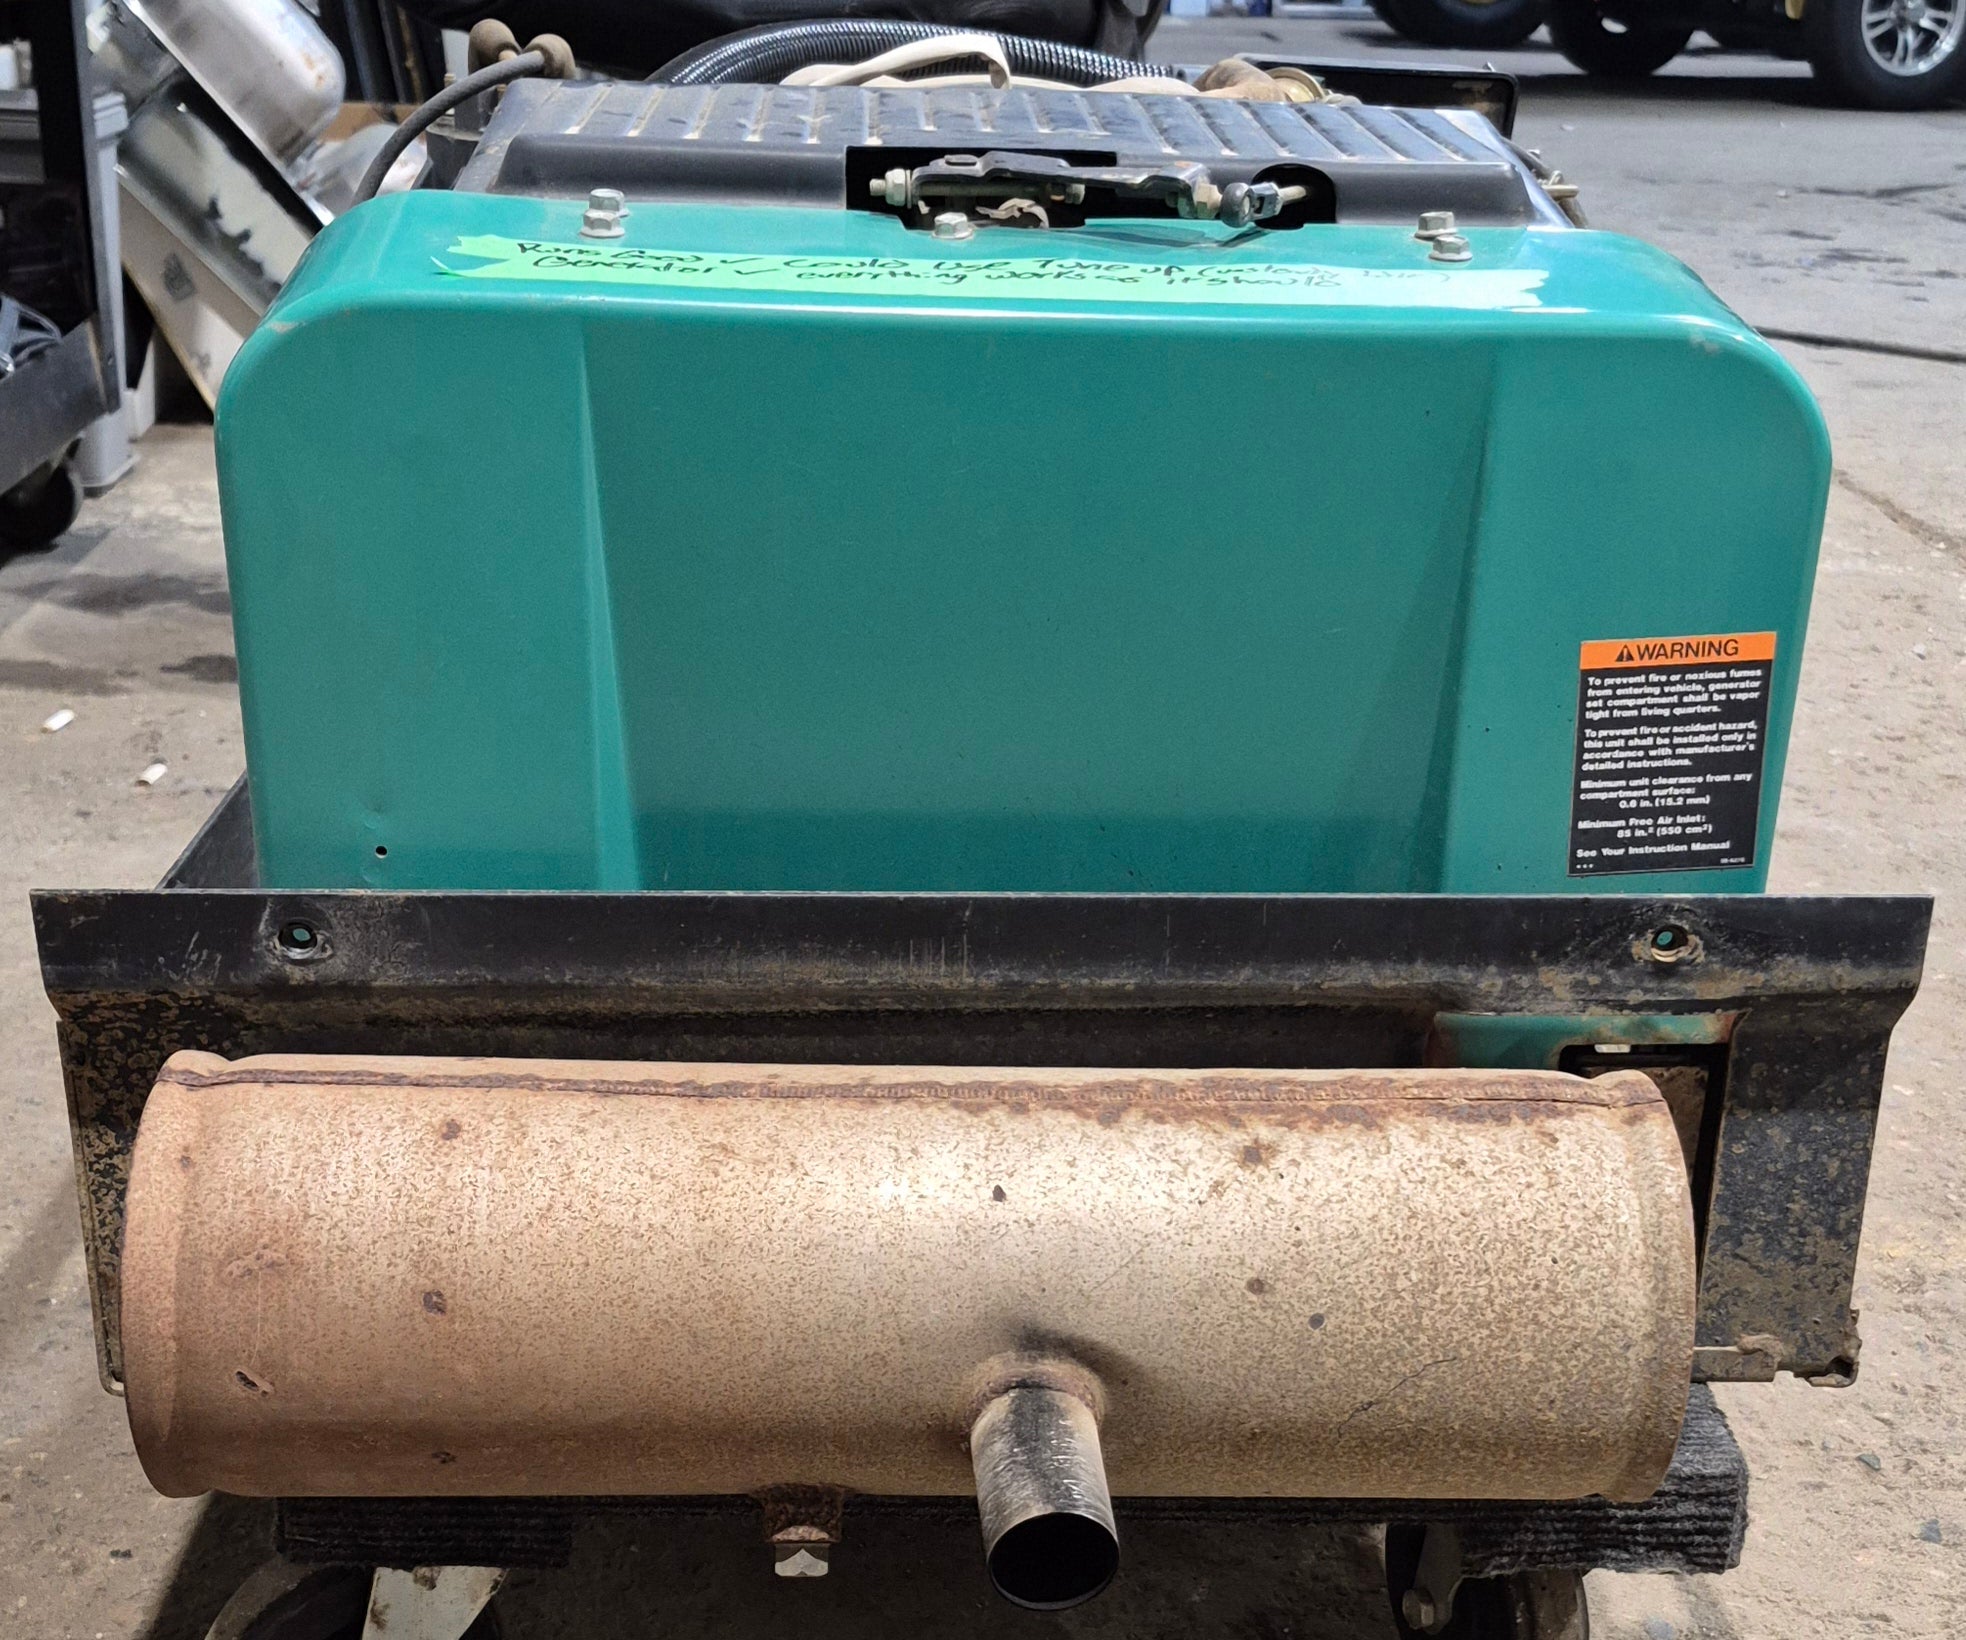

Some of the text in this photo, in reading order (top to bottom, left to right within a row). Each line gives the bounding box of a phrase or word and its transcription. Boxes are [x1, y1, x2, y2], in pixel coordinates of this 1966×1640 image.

[517, 242, 601, 256] Runs
[533, 256, 718, 273] Generator
[985, 270, 1086, 280] works
[1637, 639, 1739, 661] WARNING
[1588, 677, 1601, 686] To
[1604, 676, 1645, 686] prevent
[1649, 674, 1666, 682] fire
[1685, 671, 1726, 680] noxious
[1730, 670, 1762, 678] fumes
[1587, 680, 1762, 697] from entering vehicle, generator
[1586, 692, 1760, 707] set compartment shall be vapor
[1585, 705, 1721, 720] tight from living quarters.
[1584, 721, 1757, 738] To prevent fire or accident hazard,
[1583, 731, 1756, 748] this unit shall be installed only in
[1583, 742, 1755, 760] accordance with manufacturer's
[1581, 758, 1692, 771] detailed instructions.
[1580, 773, 1753, 789] Minimum unit clearance from any
[1580, 787, 1695, 800] compartment surface:
[1619, 795, 1710, 808] 0.6 in. (15.2 mm)
[1578, 815, 1705, 829] Minimum Free Air Inlet:
[1617, 830, 1631, 838] 85
[1656, 826, 1682, 836] (550
[1576, 841, 1730, 858] See Your Instruction Manual
